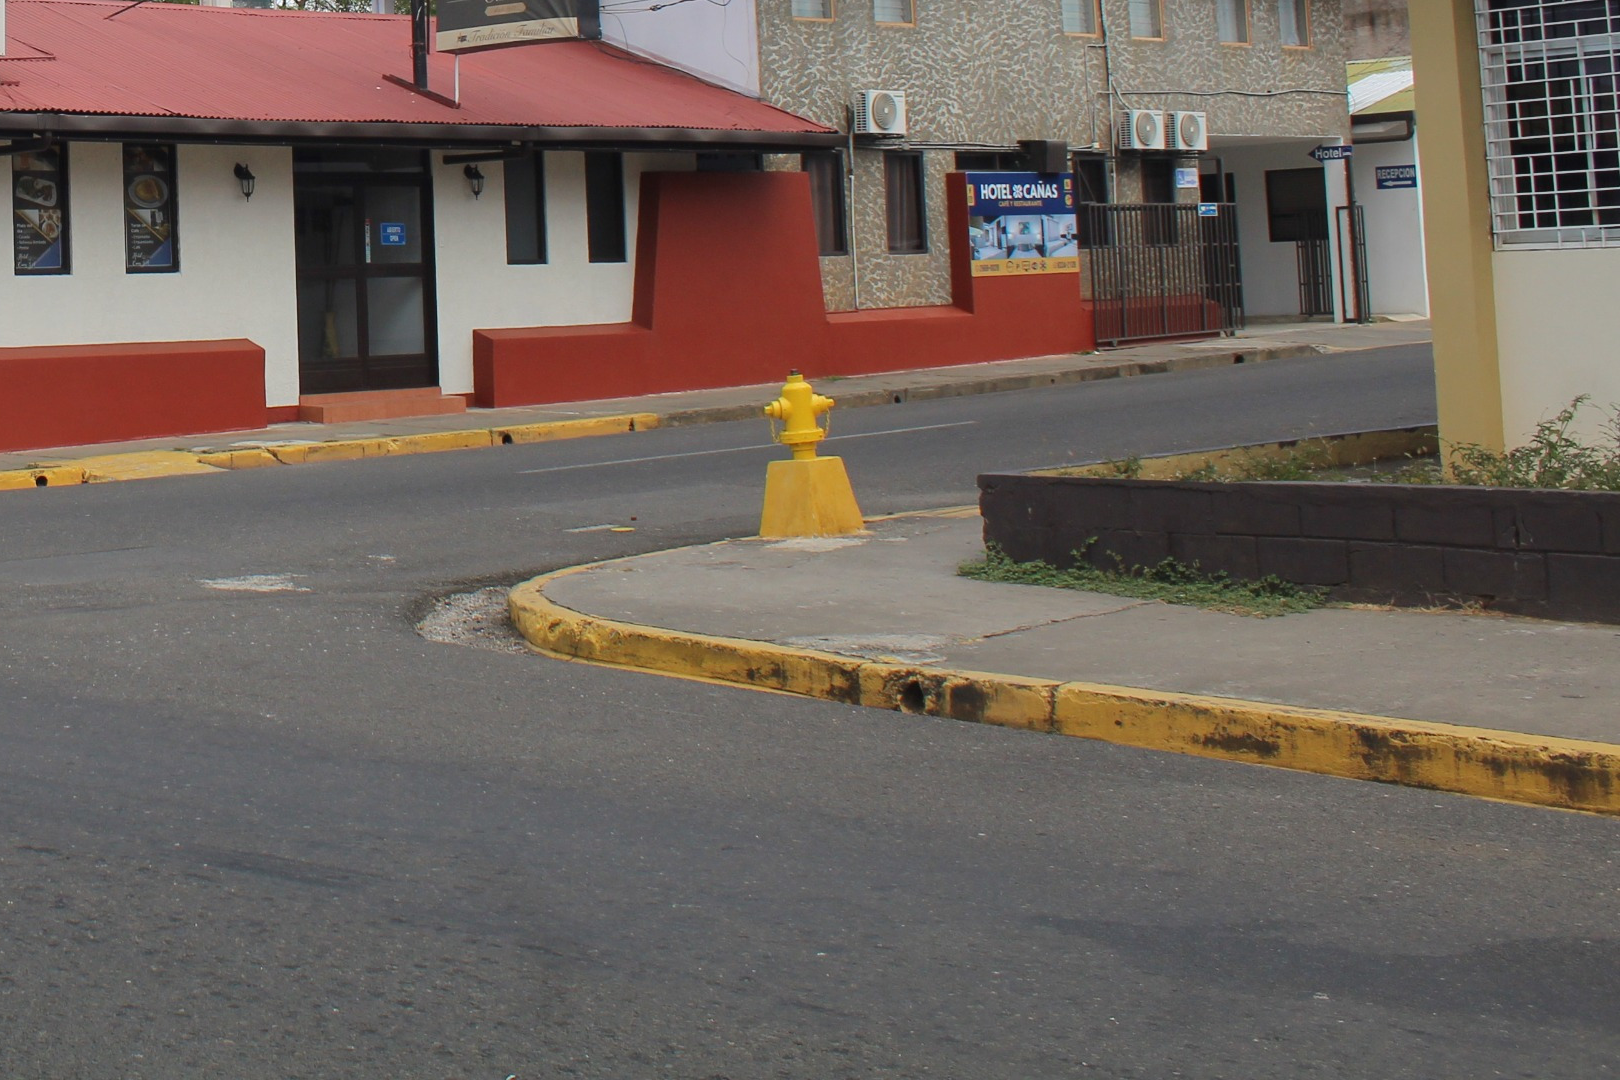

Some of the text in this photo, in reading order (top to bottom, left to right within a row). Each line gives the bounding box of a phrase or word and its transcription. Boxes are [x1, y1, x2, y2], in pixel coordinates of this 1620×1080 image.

[468, 22, 556, 42] Tradición Familiar
[1315, 147, 1342, 159] Hotel
[1377, 167, 1416, 179] RECEPCION
[980, 184, 1012, 200] HOTEL
[1023, 180, 1058, 199] CAÑAS
